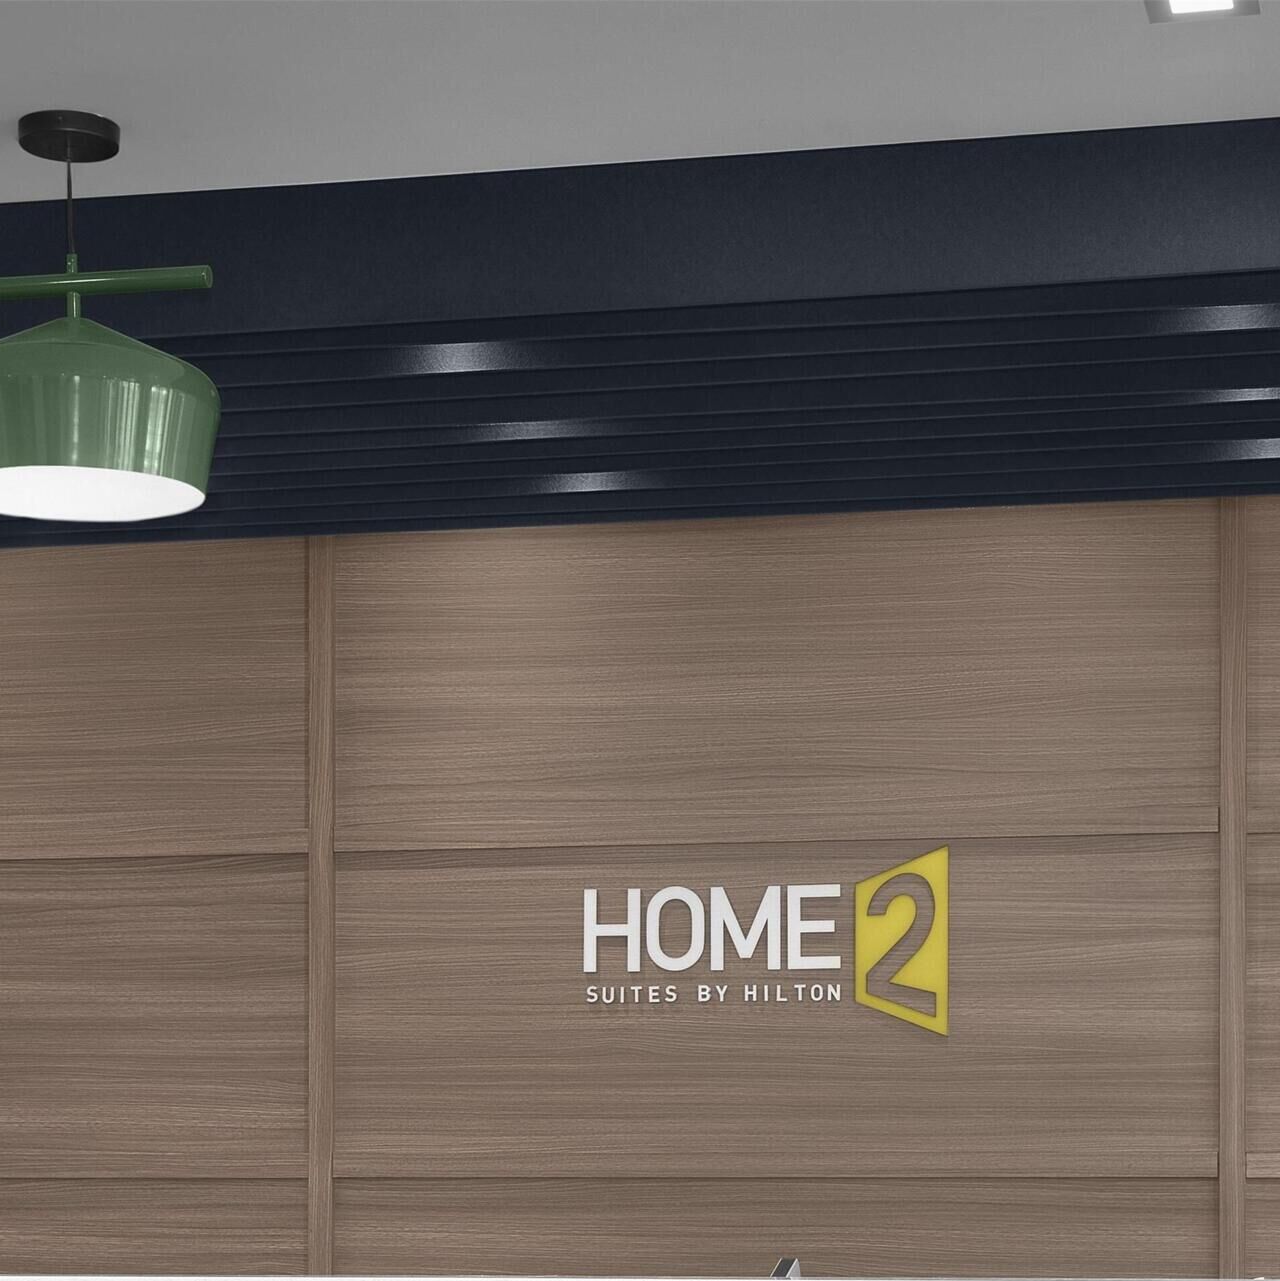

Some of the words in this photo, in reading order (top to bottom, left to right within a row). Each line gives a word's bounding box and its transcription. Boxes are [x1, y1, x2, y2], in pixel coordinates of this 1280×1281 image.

[583, 884, 842, 973] HOME
[866, 872, 937, 1017] 2
[586, 984, 679, 1004] SUITES
[697, 984, 729, 1003] BY
[743, 983, 842, 1003] HILTON
